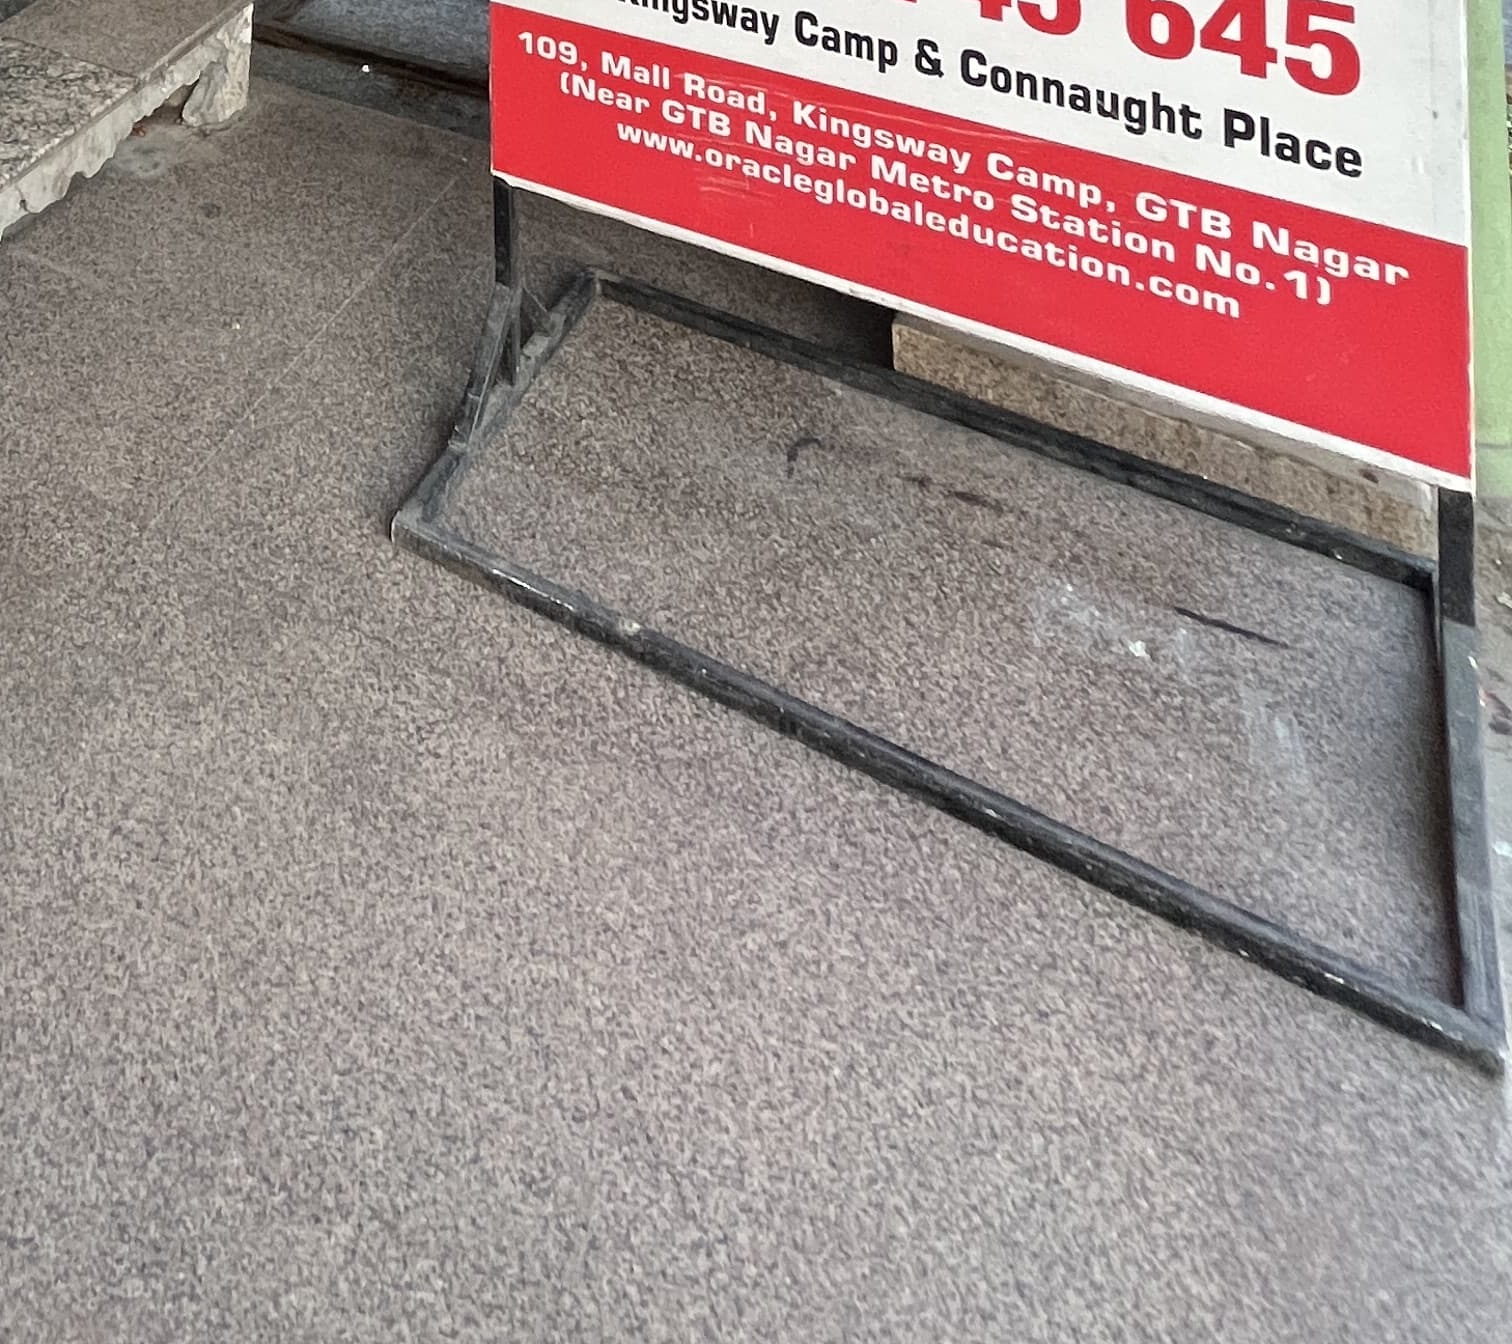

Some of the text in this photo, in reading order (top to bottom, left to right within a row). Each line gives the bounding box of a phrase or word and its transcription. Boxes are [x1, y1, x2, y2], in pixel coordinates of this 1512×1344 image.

[517, 32, 1410, 288] 109, Mall Road, Kingsway Camp, GTB Nagar
[558, 72, 1332, 306] (Near GTB Nagar Metro Station No.1)
[794, 13, 898, 78] Camp
[915, 39, 944, 77] &
[959, 51, 1203, 142] Connaught
[1222, 108, 1364, 179] Place
[616, 118, 1241, 319] www.oracleglobaleducation.com
